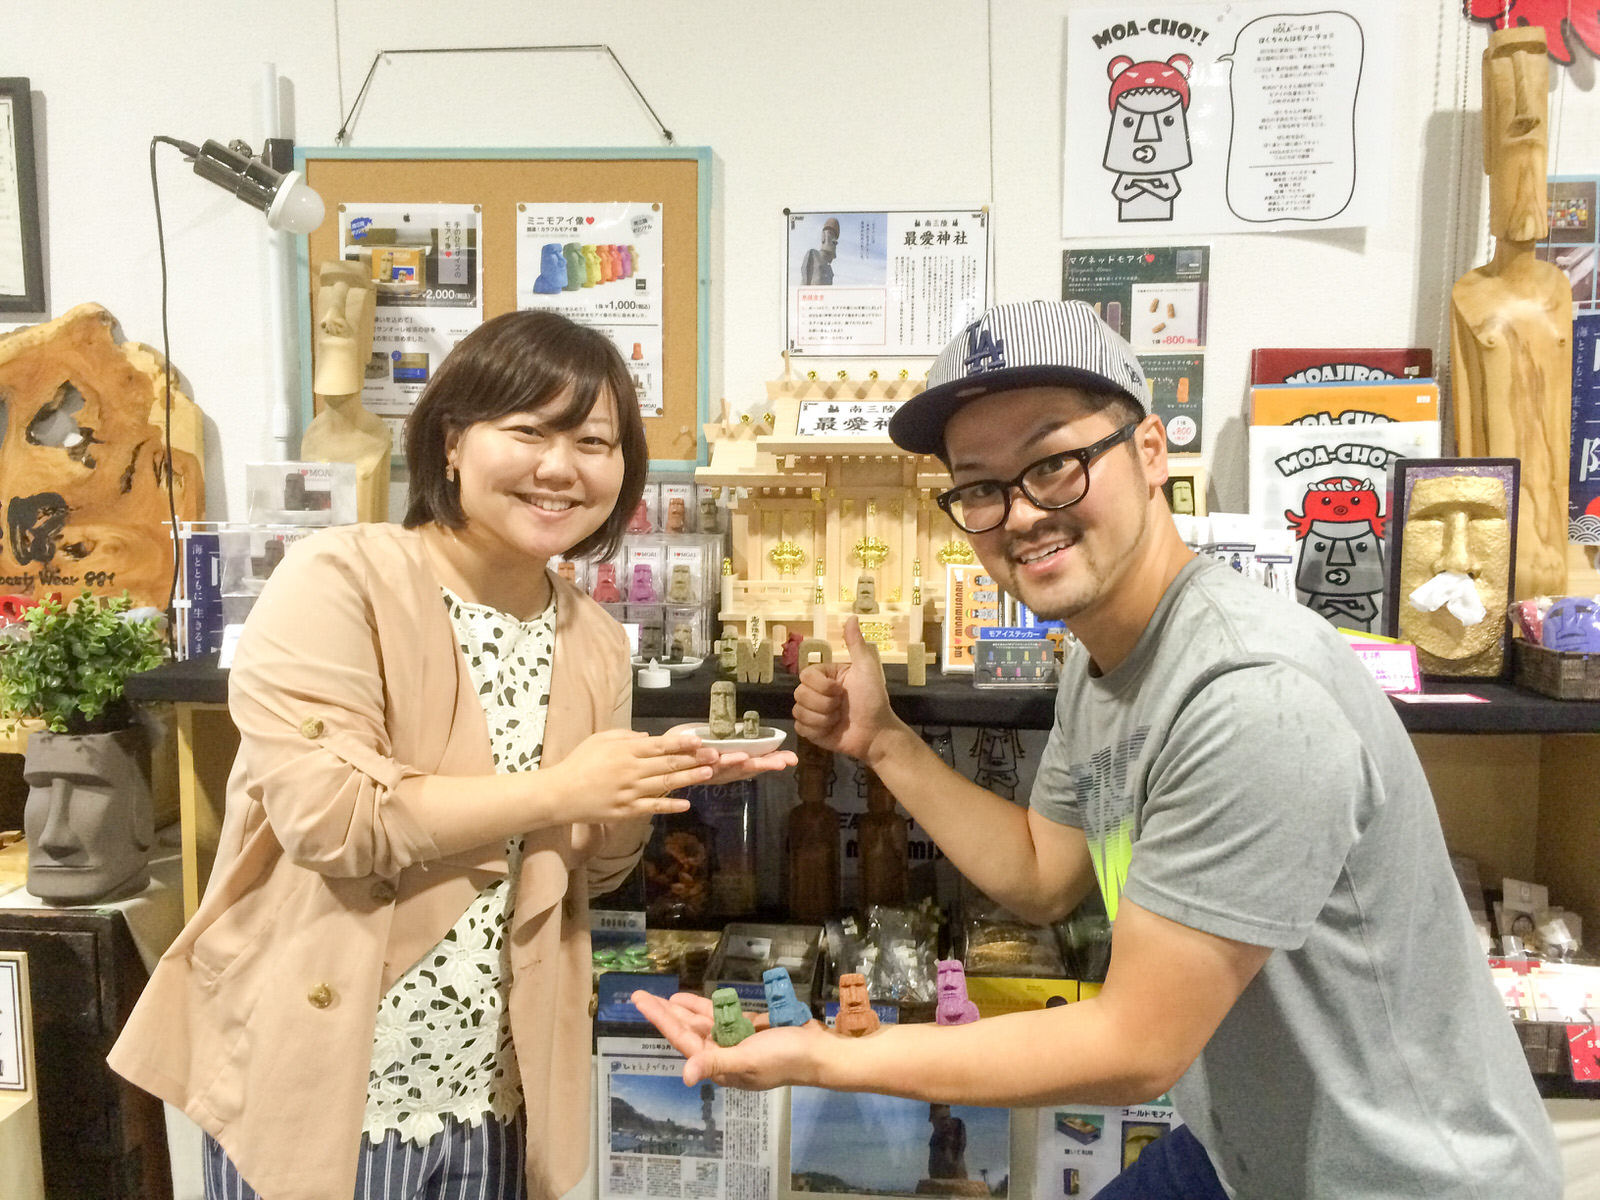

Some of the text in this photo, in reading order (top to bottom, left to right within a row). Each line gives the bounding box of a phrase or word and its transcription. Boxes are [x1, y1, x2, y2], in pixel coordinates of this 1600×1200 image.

[1092, 18, 1209, 50] MOA-CHO!!
[527, 216, 584, 226] ミニモアイ像
[904, 230, 968, 246] 最愛神社
[192, 544, 203, 601] 海とともに
[988, 630, 1041, 638] モアイステッカー
